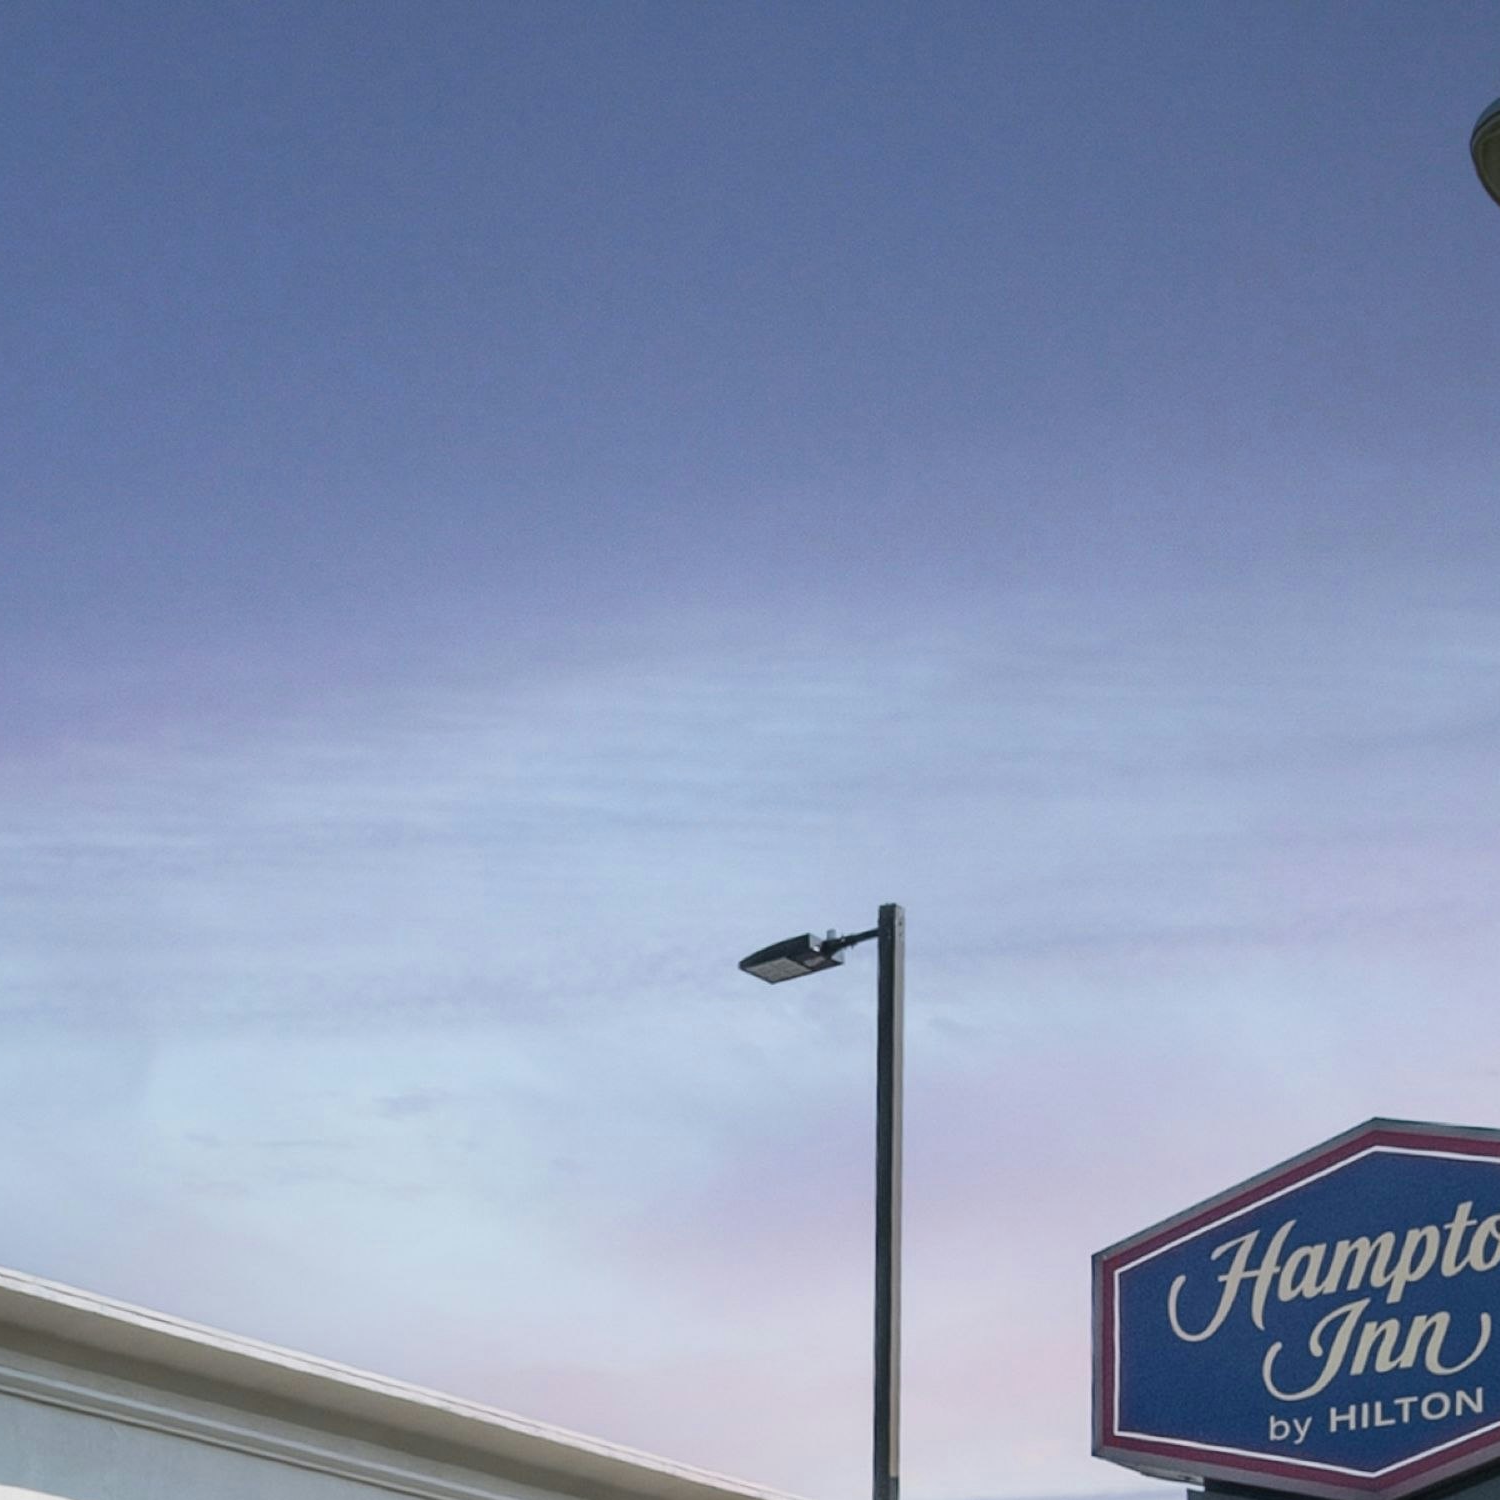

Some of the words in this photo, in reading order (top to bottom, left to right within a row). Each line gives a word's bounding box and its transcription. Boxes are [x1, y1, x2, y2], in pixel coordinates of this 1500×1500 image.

[1262, 1298, 1491, 1401] Inn
[1269, 1415, 1313, 1445] by
[1329, 1387, 1484, 1433] HILTON
